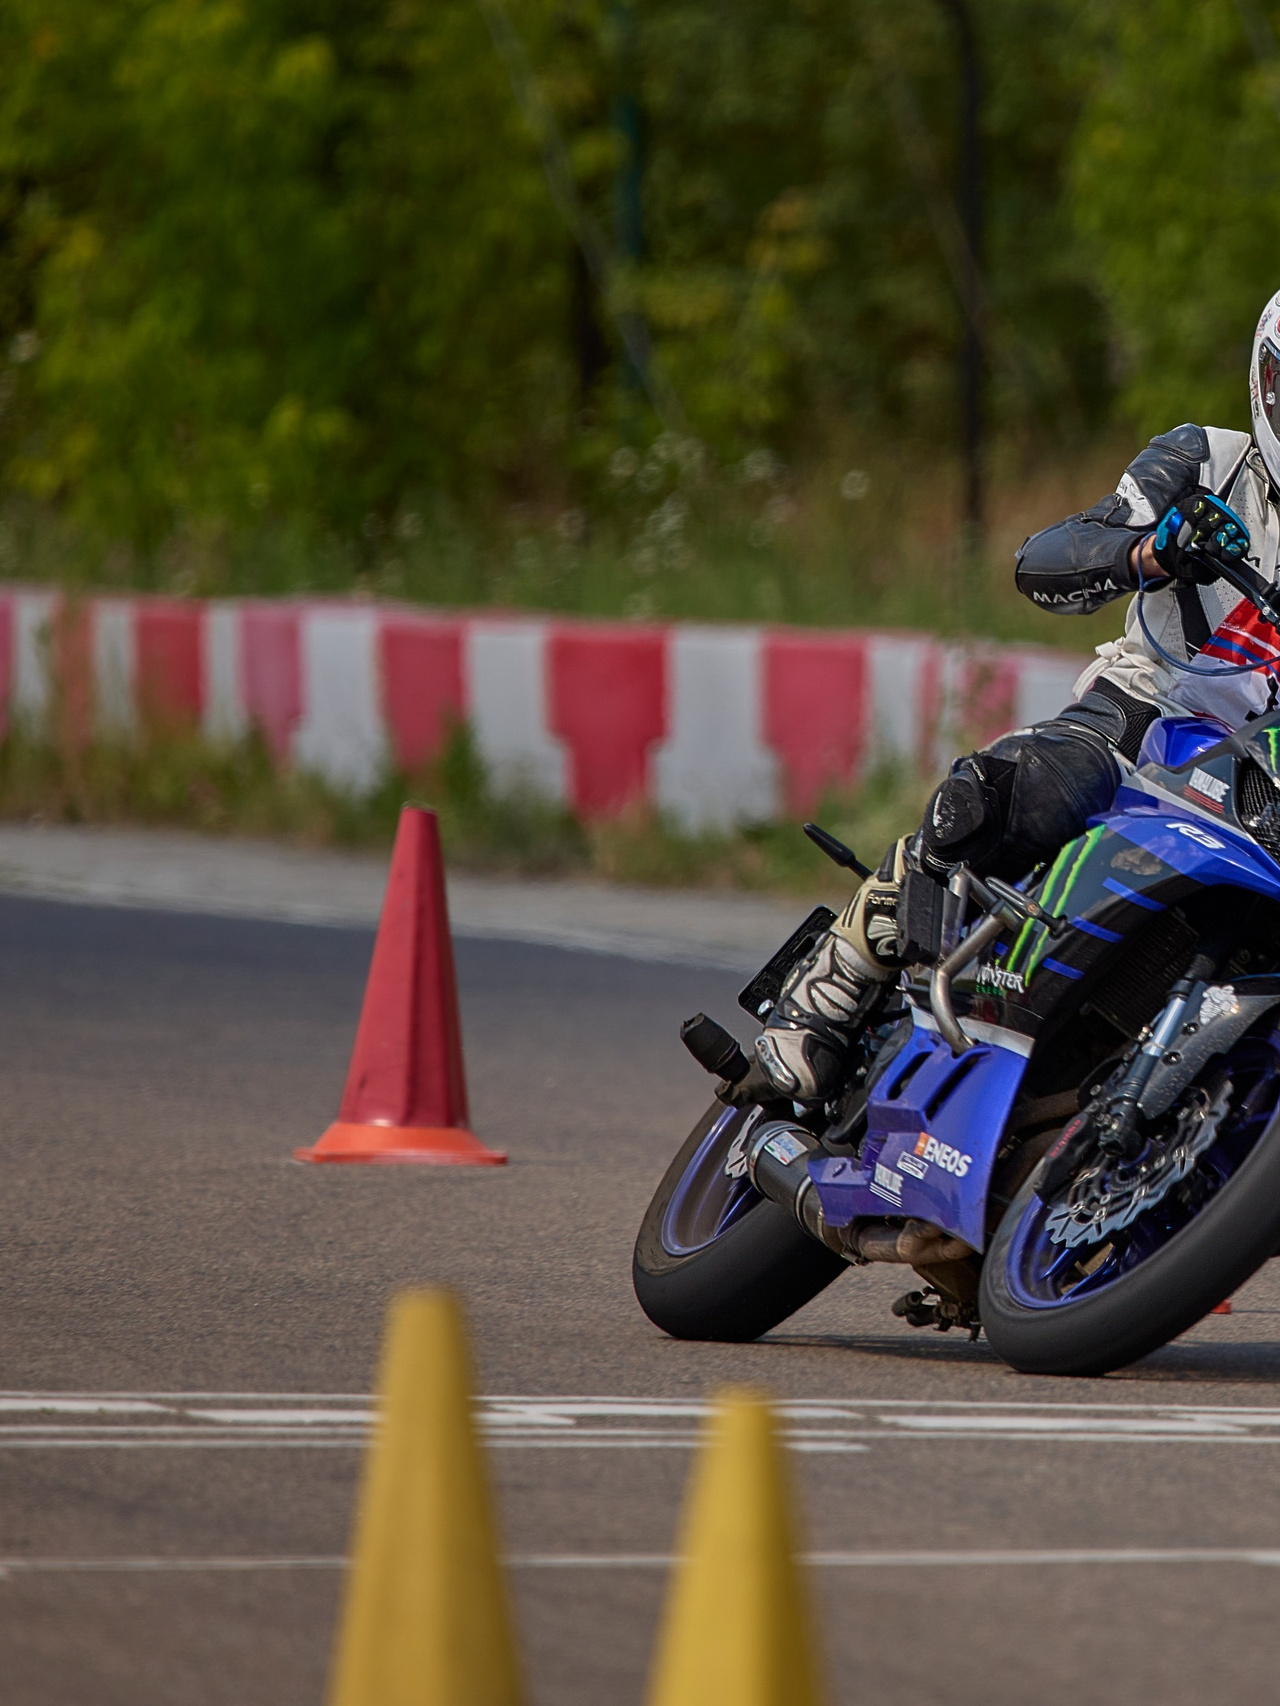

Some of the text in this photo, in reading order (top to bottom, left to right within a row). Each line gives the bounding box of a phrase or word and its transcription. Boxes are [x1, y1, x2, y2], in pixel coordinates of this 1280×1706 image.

[1033, 578, 1118, 603] MACNA
[1165, 823, 1226, 849] R3
[922, 1136, 972, 1178] ENEOS
